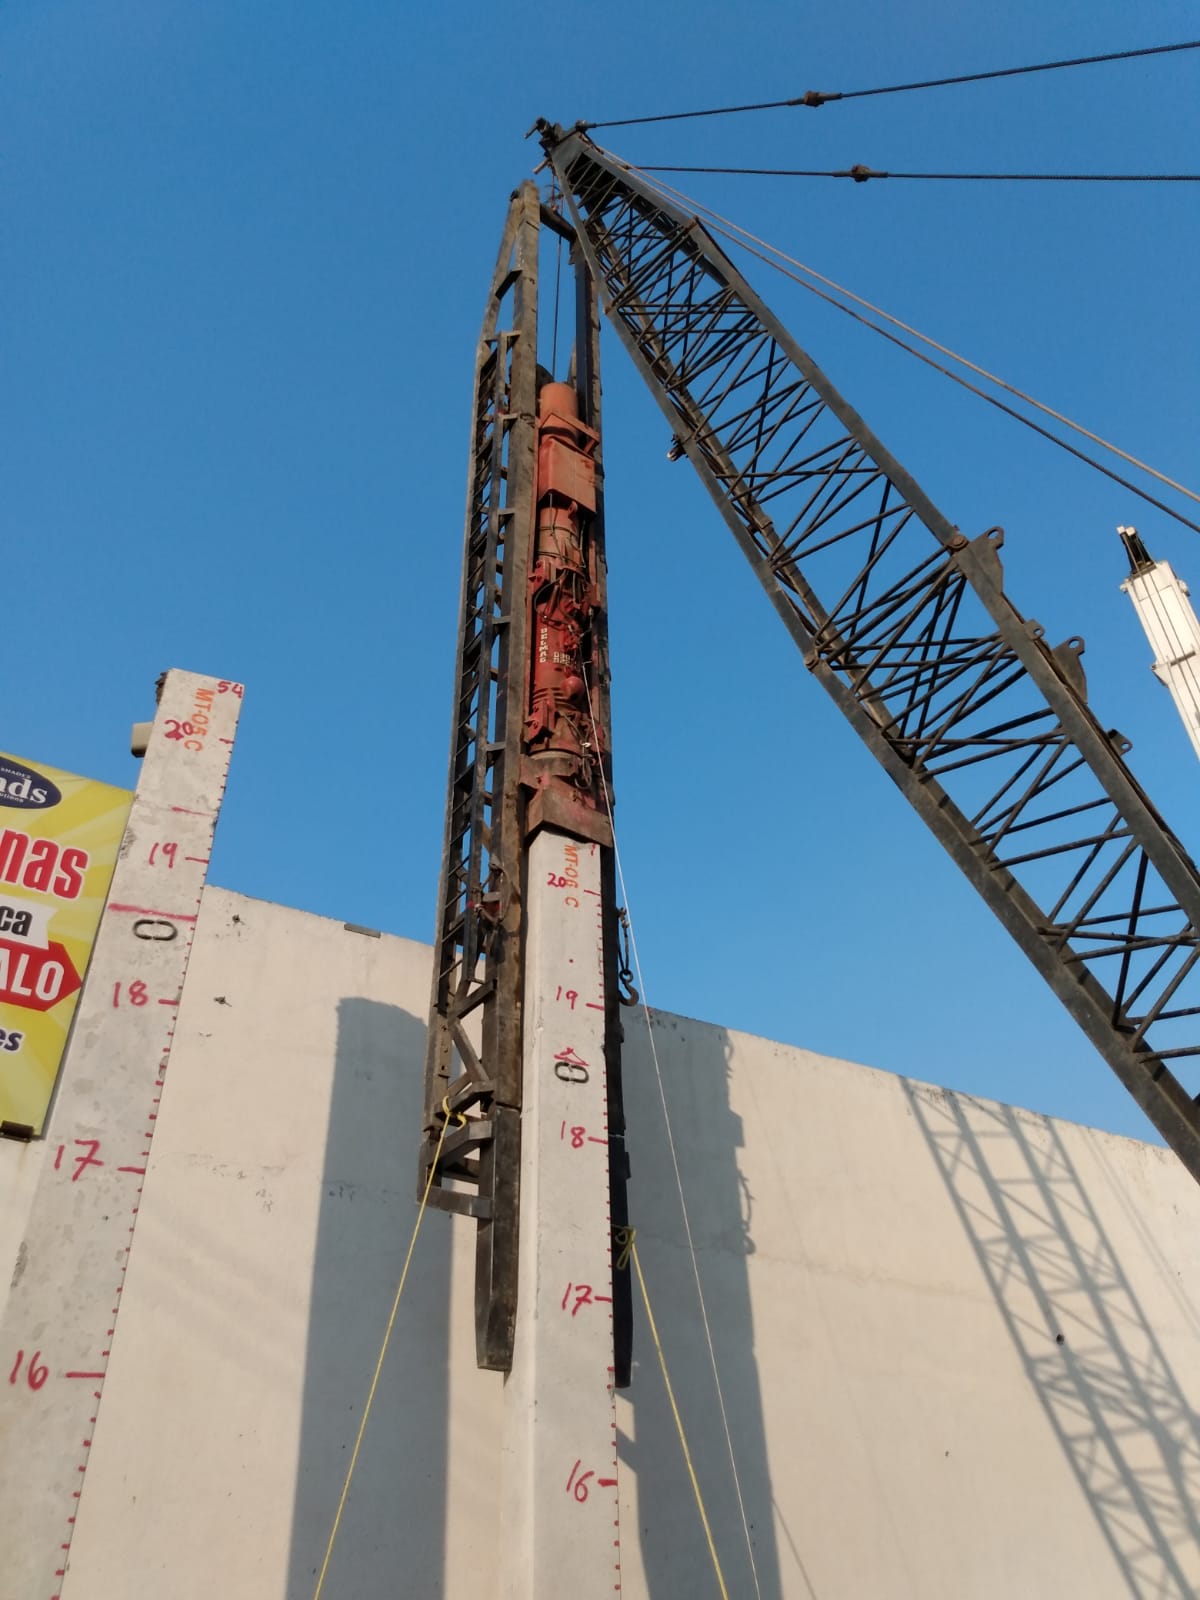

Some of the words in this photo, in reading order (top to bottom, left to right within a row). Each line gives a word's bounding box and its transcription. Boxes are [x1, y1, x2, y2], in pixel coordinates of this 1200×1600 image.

[217, 680, 243, 700] 54
[164, 719, 194, 741] 20
[183, 739, 203, 752] C
[148, 842, 178, 868] 19
[547, 872, 566, 888] 20
[564, 896, 579, 908] C
[112, 979, 149, 1008] 18
[556, 985, 578, 1010] 19
[560, 1120, 586, 1148] 18
[54, 1139, 104, 1181] 17
[561, 1282, 593, 1317] 17
[9, 1350, 49, 1391] 16
[566, 1459, 595, 1503] 16
